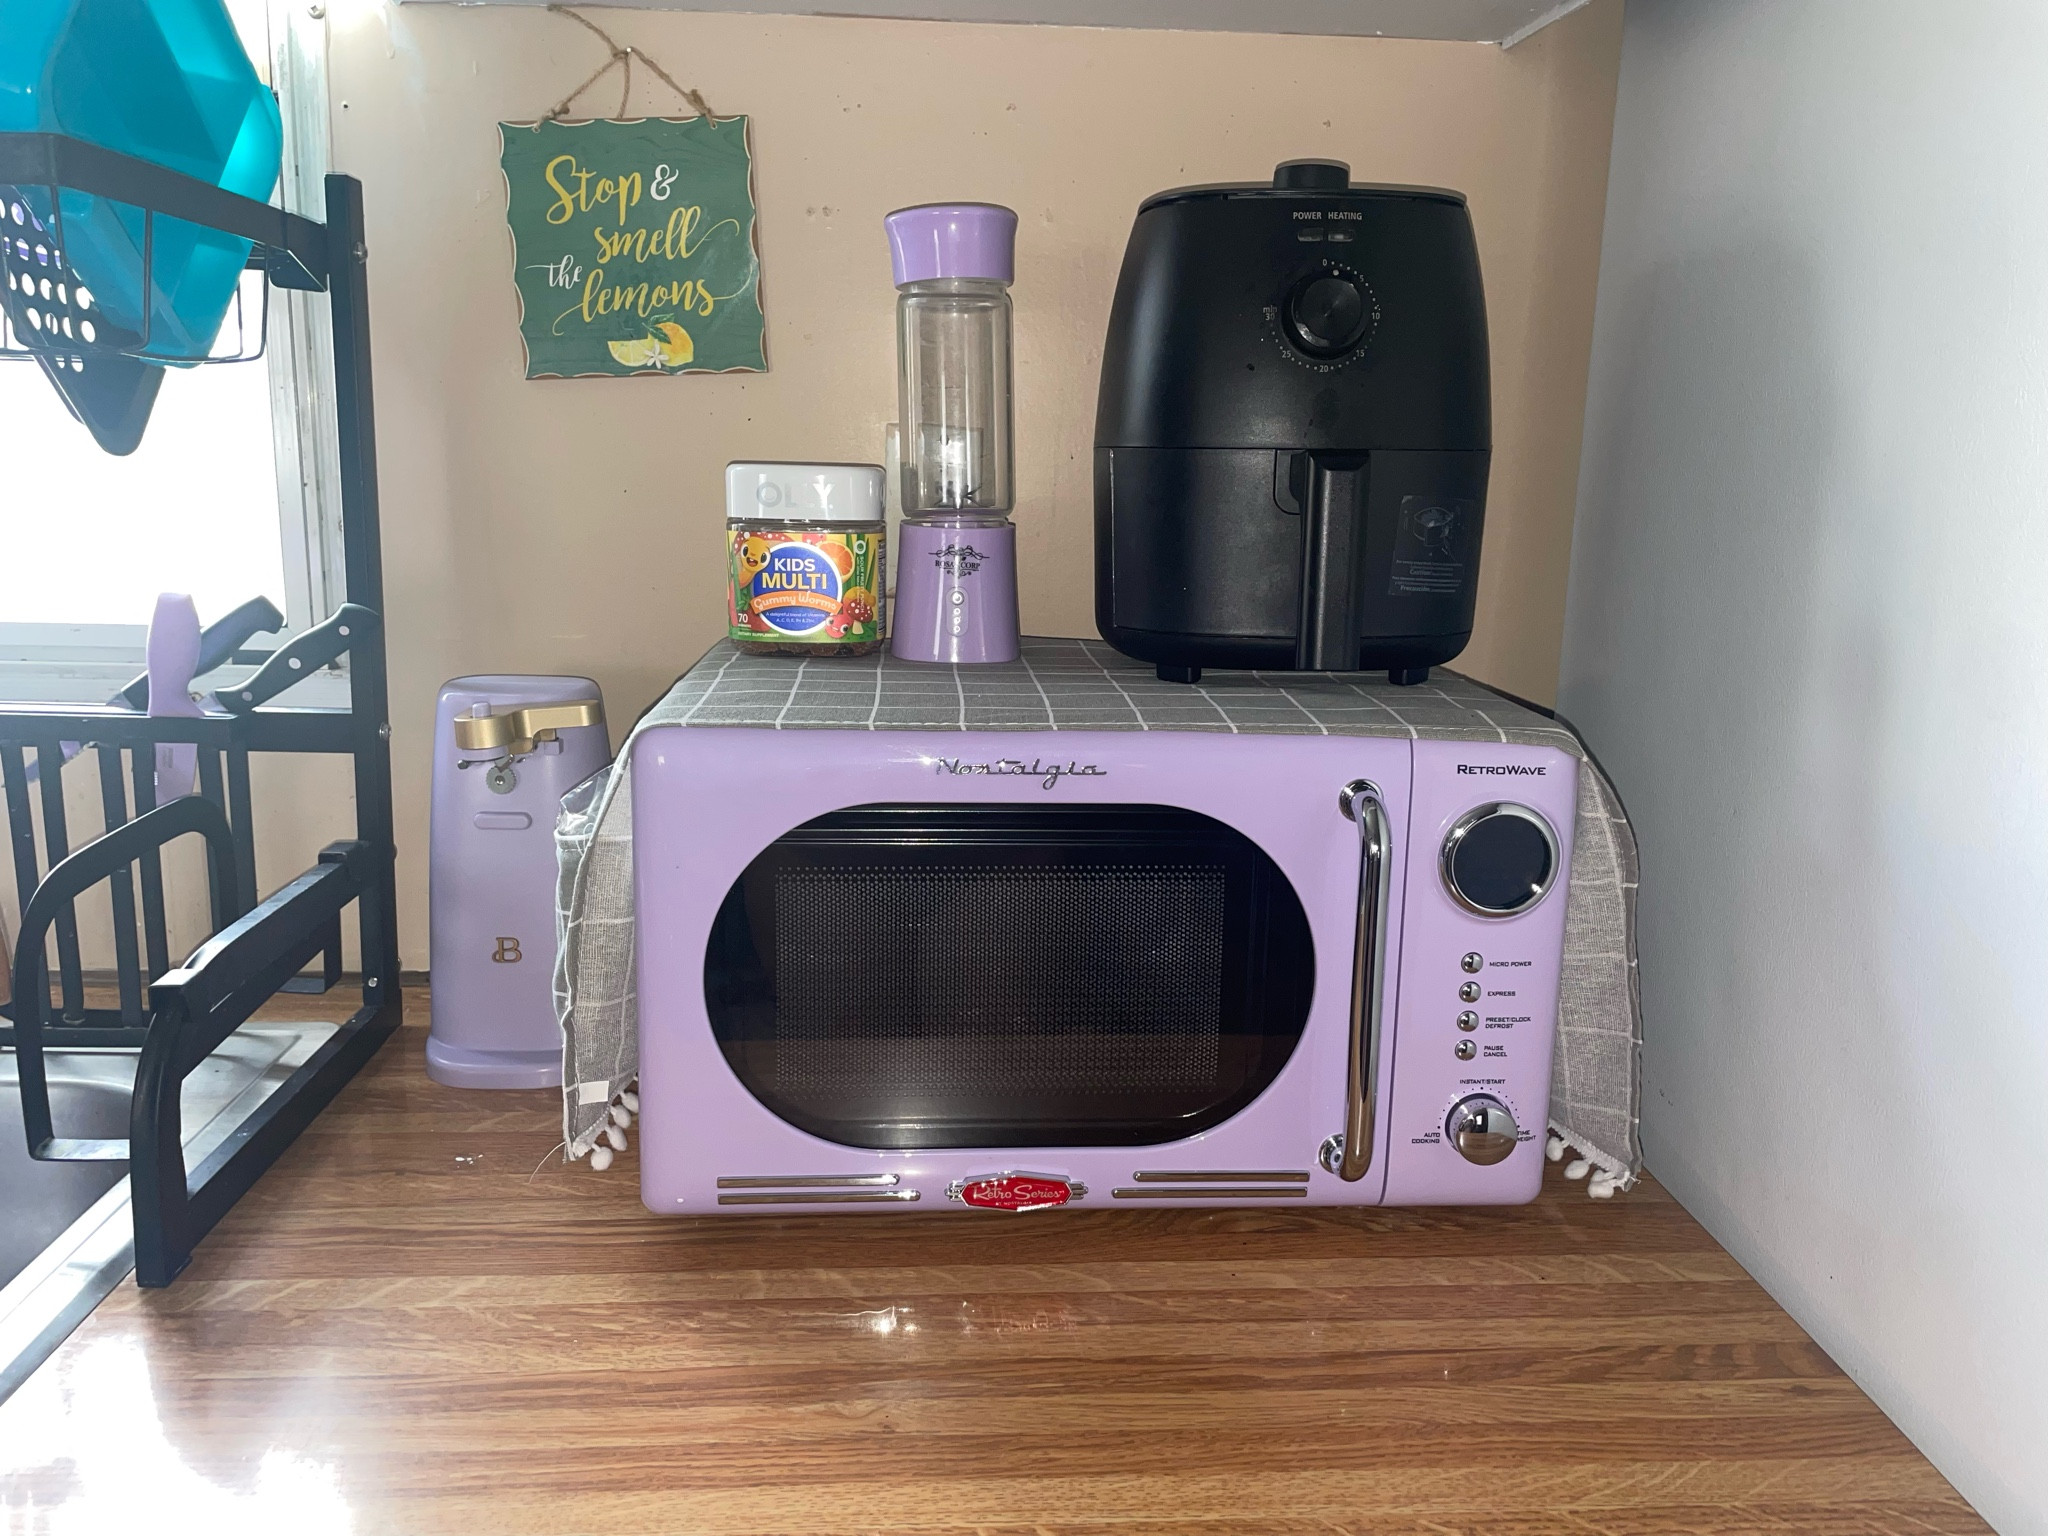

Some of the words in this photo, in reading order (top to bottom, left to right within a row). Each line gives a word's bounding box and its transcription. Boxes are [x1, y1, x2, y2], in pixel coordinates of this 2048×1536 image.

[545, 155, 642, 226] Stop
[650, 164, 679, 201] &
[1292, 211, 1322, 220] POWER
[1327, 211, 1363, 221] HEATING
[594, 205, 739, 264] smell
[1322, 259, 1328, 267] 0
[1262, 305, 1278, 313] min
[1371, 312, 1380, 320] 10
[1281, 350, 1291, 359] 25
[1319, 364, 1329, 373] 20
[774, 557, 816, 572] KIDS
[762, 572, 827, 590] MULTI
[753, 594, 797, 612] Gummy
[798, 590, 837, 611] Worms
[737, 612, 749, 623] 70
[935, 757, 1108, 790] Nostalgia
[491, 936, 523, 964] B
[972, 1184, 1012, 1201] Retro
